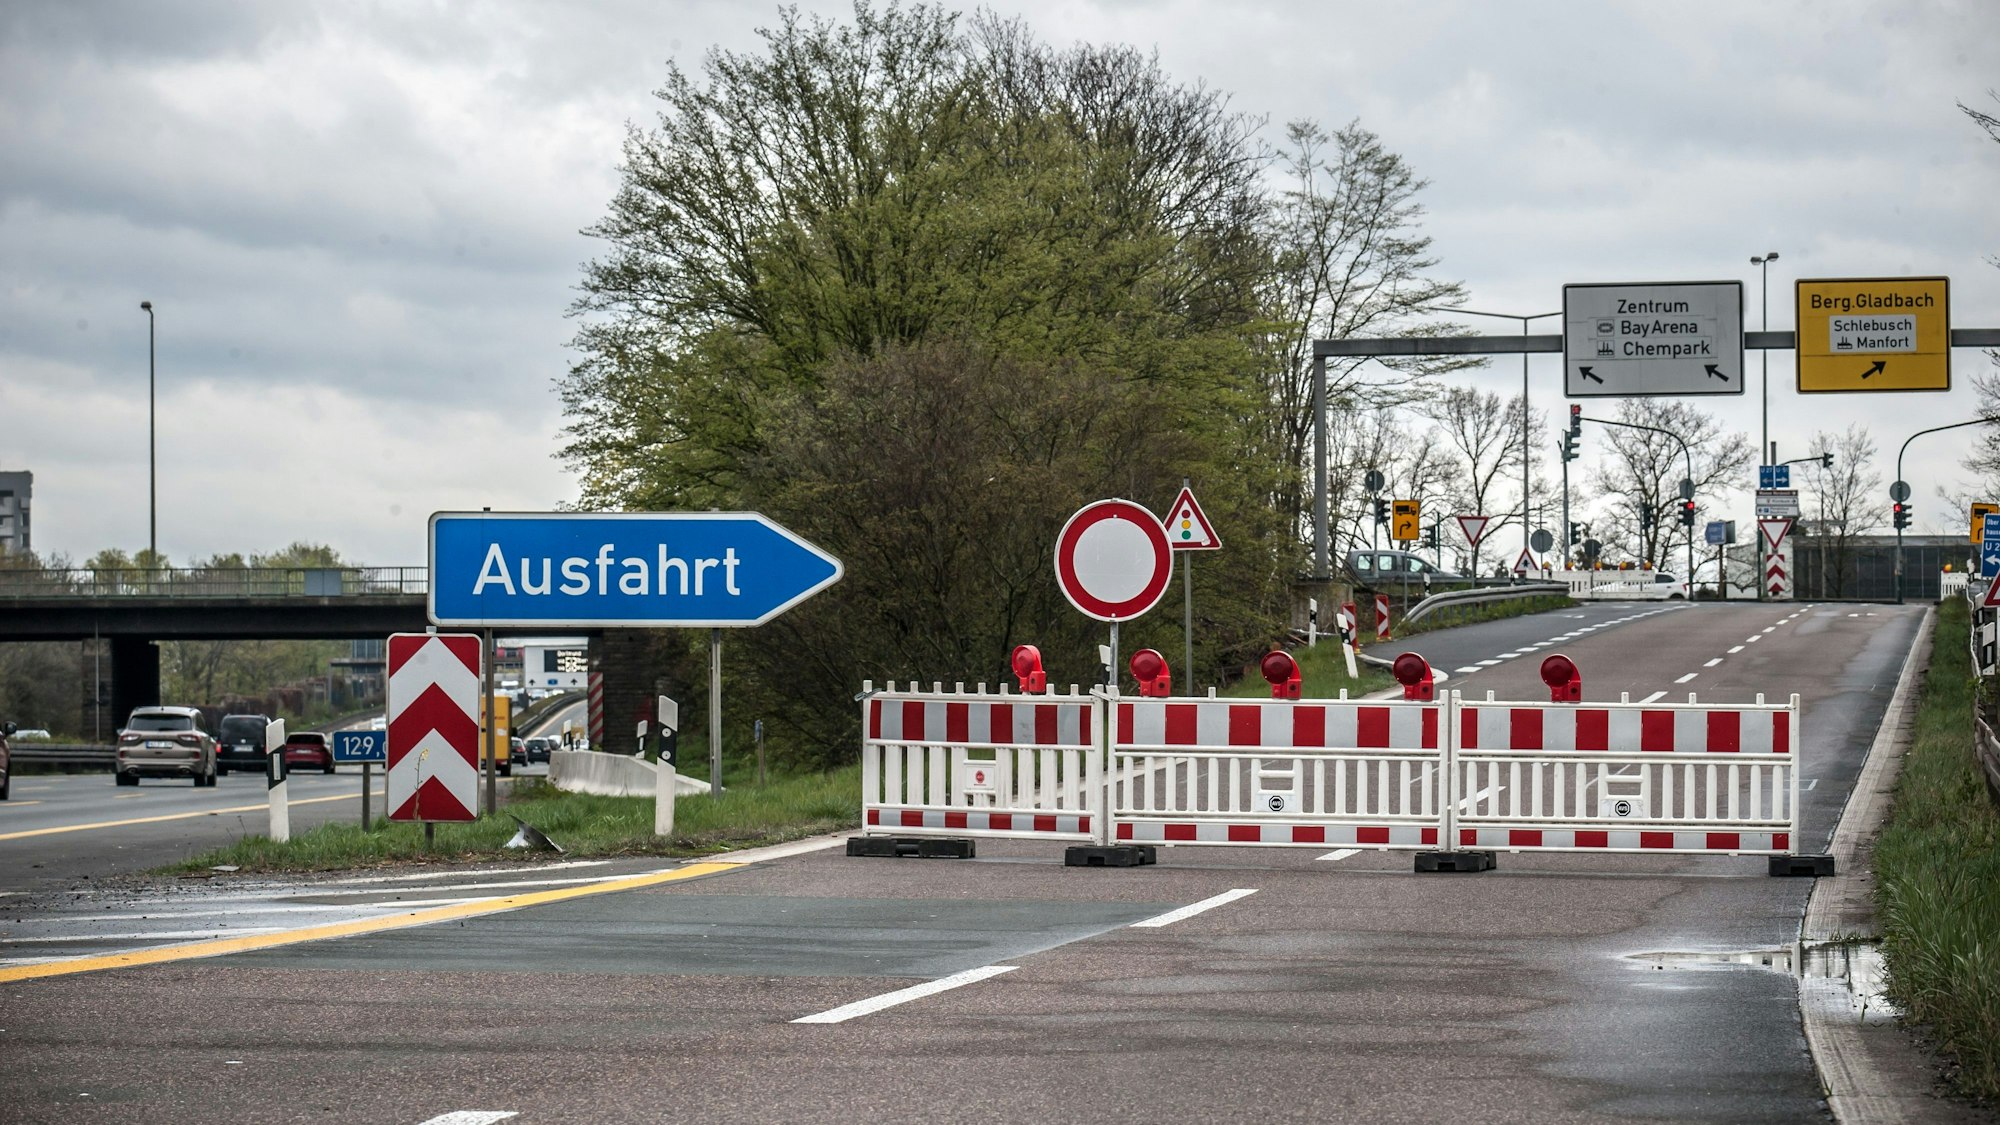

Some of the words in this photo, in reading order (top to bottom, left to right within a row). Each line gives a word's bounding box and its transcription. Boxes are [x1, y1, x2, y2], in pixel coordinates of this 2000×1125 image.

[1617, 300, 1689, 314] Zentrum
[1834, 319, 1912, 332] Schlebusch
[1857, 336, 1909, 348] Manfort
[1623, 340, 1711, 359] Chempark
[1985, 542, 1992, 551] U
[472, 543, 740, 596] Ausfahrt
